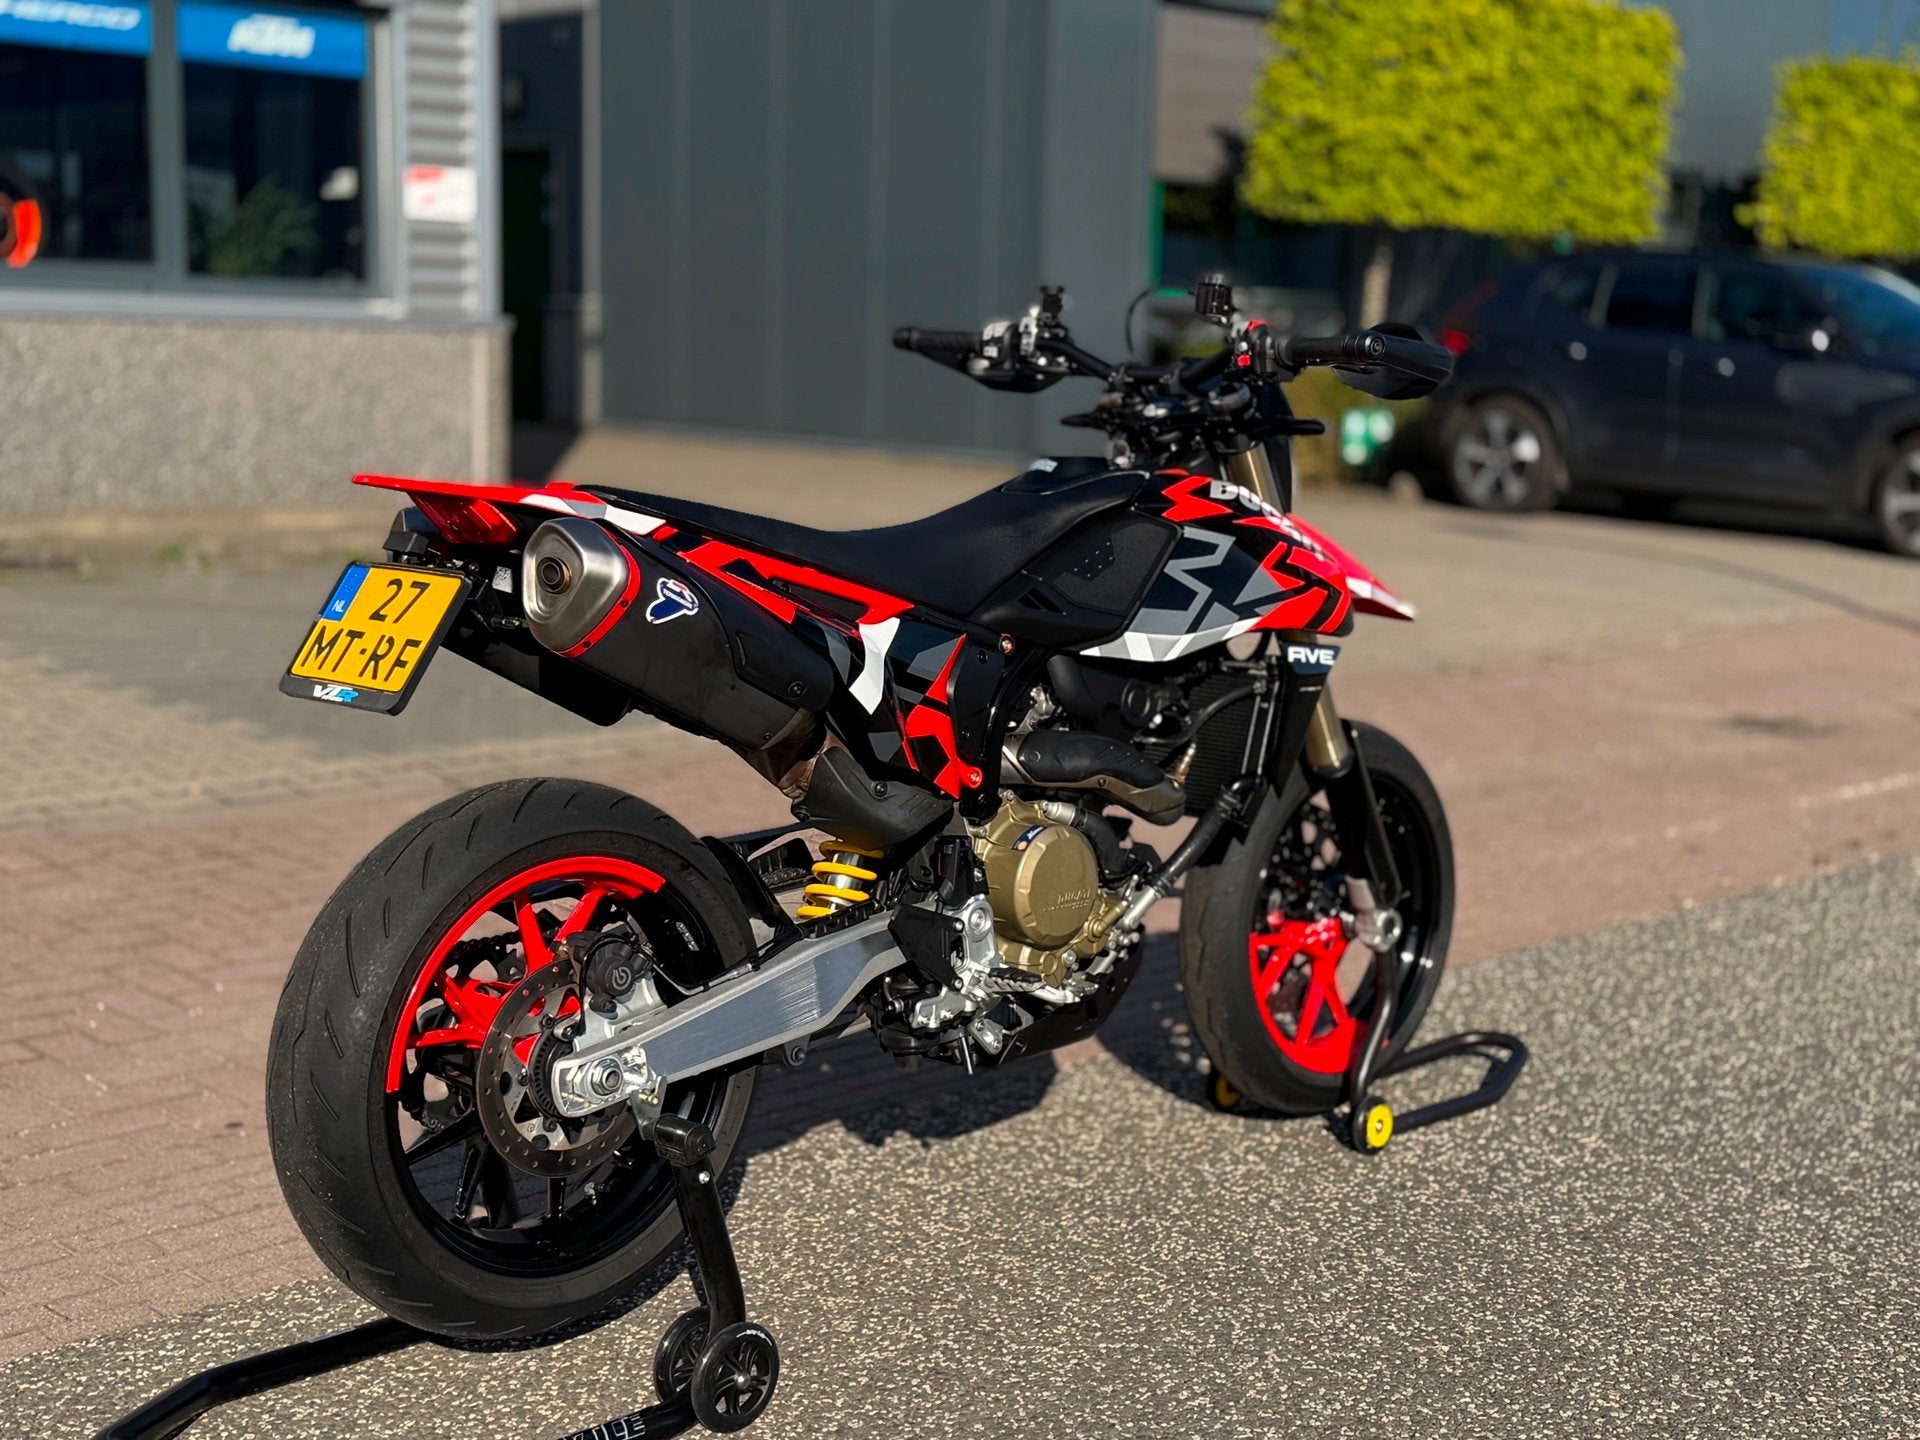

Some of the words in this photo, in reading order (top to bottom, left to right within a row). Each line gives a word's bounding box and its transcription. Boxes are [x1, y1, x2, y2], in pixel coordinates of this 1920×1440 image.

[226, 13, 316, 59] KTM
[332, 600, 345, 612] NL
[369, 578, 430, 624] 27
